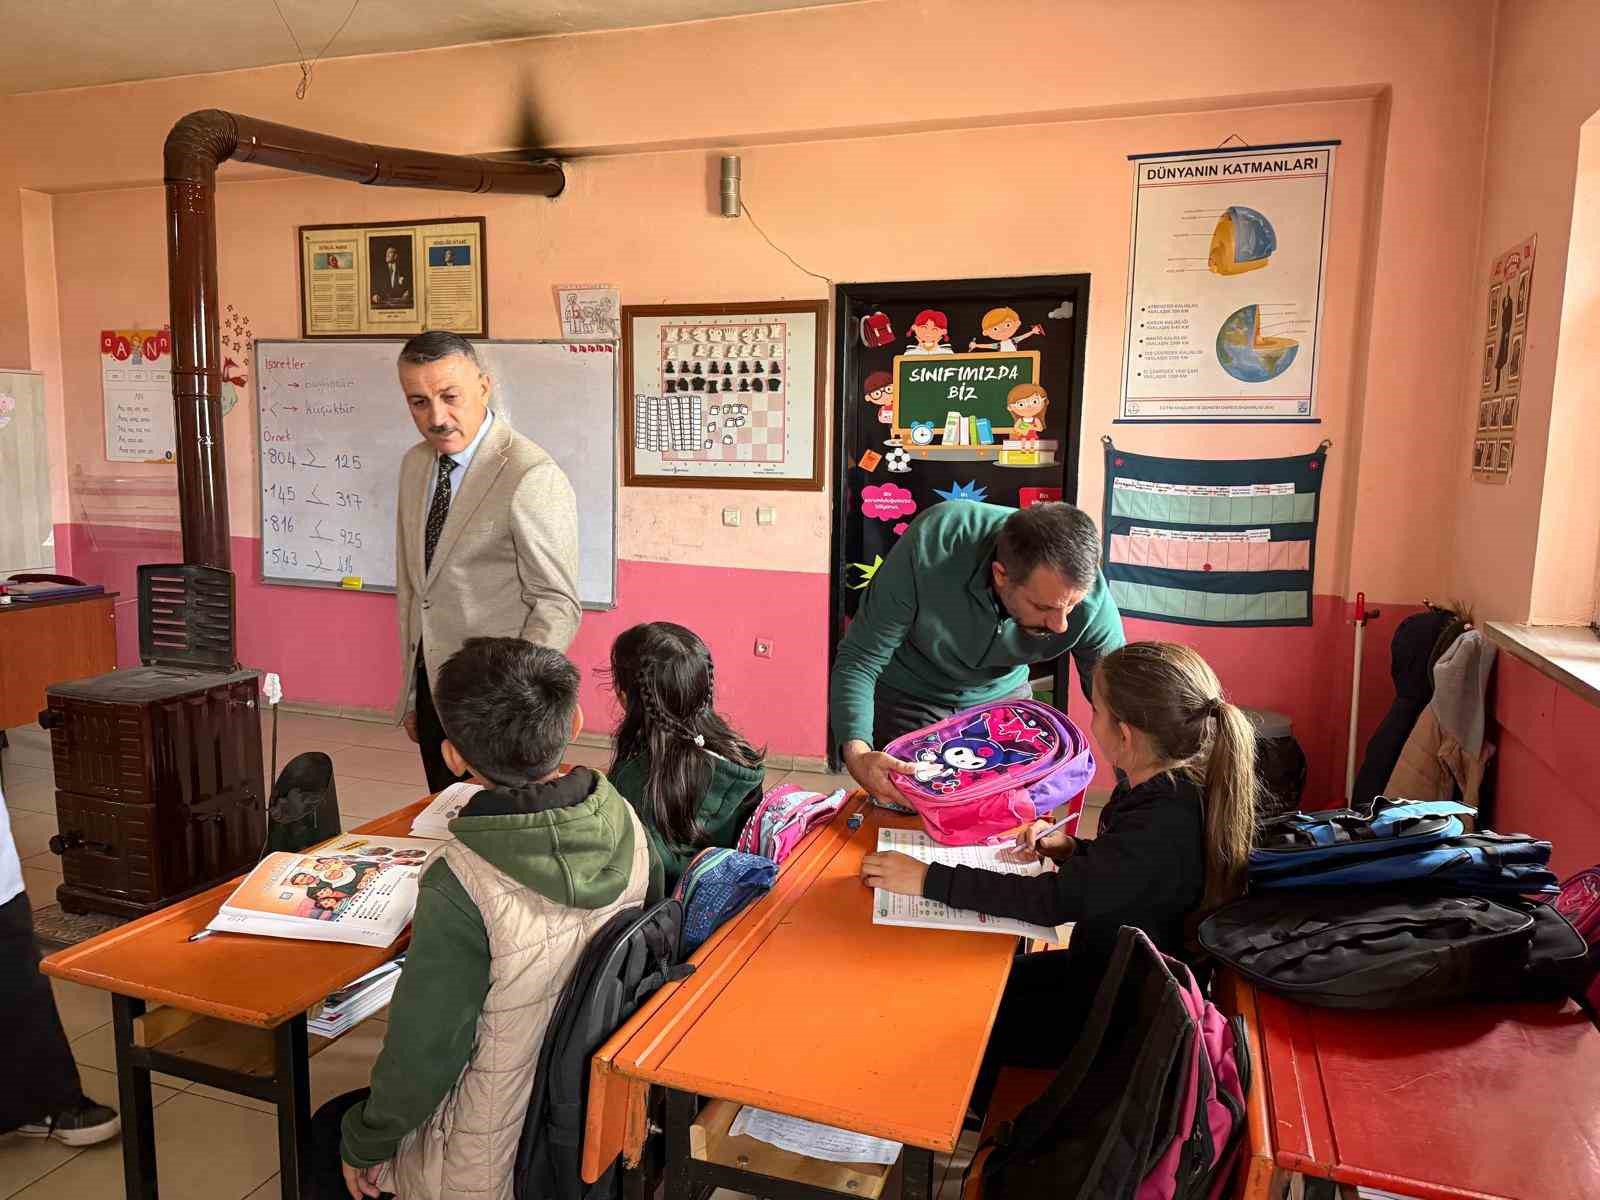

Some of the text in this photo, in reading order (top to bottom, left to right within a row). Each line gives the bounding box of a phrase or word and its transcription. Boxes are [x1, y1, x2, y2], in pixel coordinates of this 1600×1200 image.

[1147, 157, 1318, 180] DÜNYANIN KATMANLARI
[116, 341, 128, 358] A
[146, 339, 158, 357] N
[909, 364, 1018, 382] SINIFIMIZDA
[947, 382, 978, 401] BİZ
[269, 448, 297, 471] 804
[335, 453, 362, 470] 125
[270, 483, 296, 504] 145
[336, 491, 363, 511] 317
[270, 514, 294, 533] 816
[340, 529, 363, 549] 925
[271, 548, 298, 566] 543
